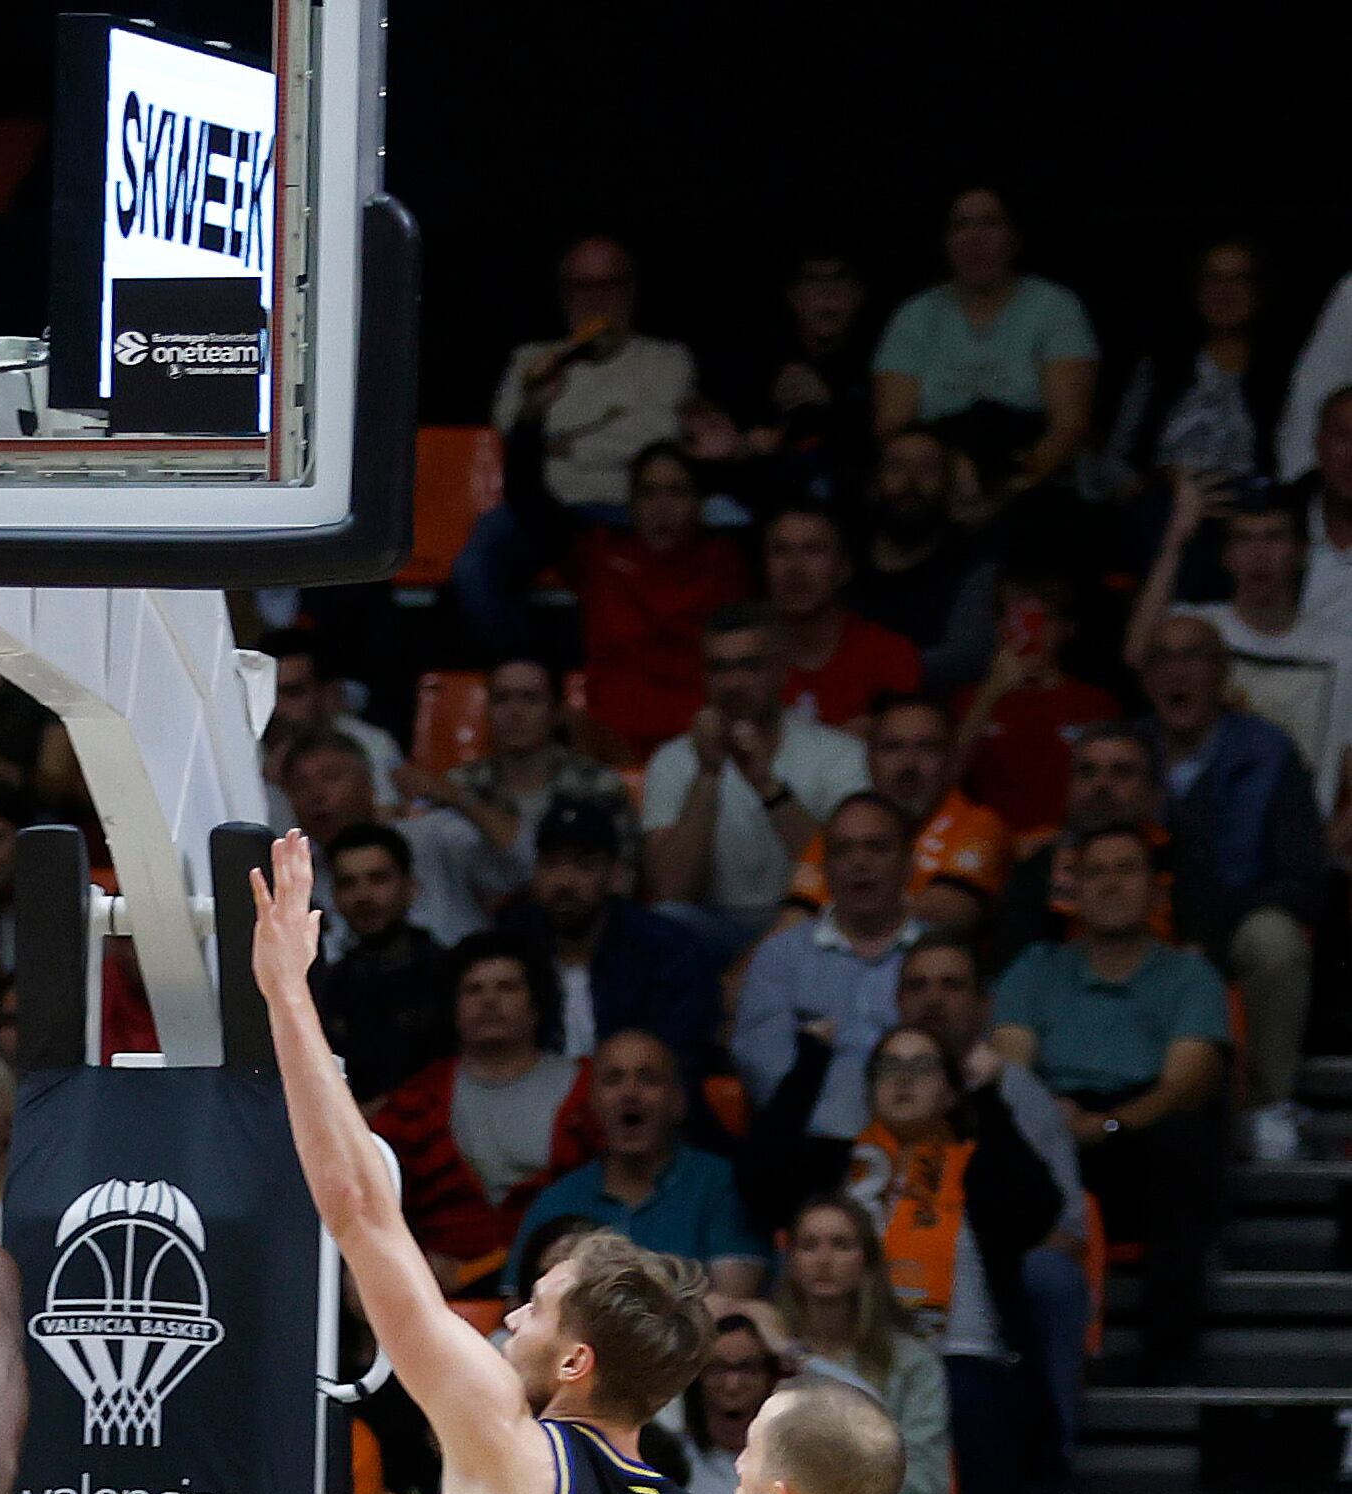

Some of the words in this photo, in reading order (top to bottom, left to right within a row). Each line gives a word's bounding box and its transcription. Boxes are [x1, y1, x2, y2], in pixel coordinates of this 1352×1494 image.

[115, 91, 276, 272] SKWEEK
[151, 344, 259, 364] oneteam
[41, 1317, 135, 1335] VALENCIA
[140, 1319, 213, 1339] BASKET
